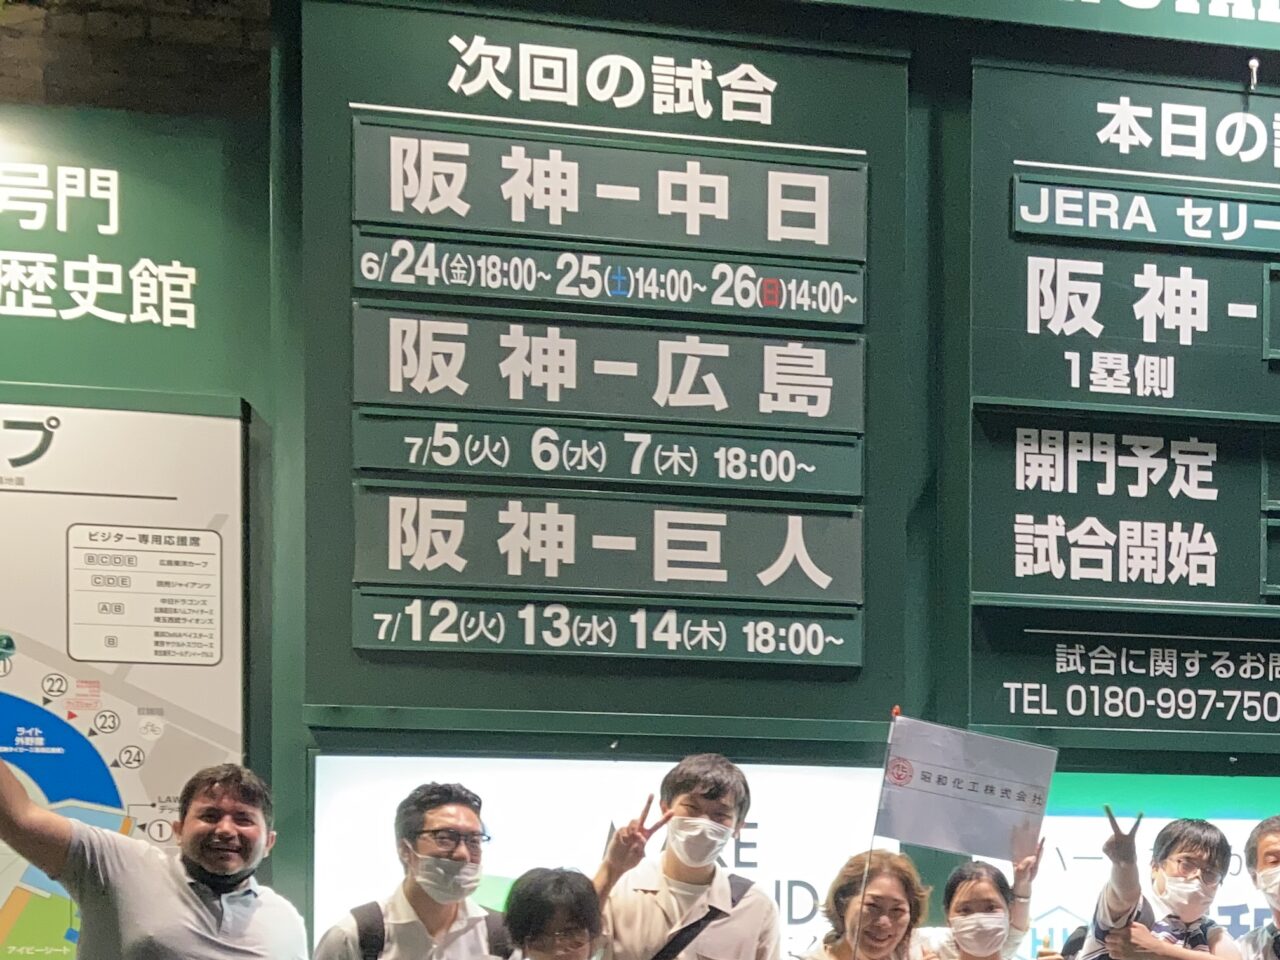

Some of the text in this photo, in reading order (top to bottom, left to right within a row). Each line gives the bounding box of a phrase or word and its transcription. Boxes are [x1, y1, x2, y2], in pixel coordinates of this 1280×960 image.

[447, 34, 778, 125] 次回の試合
[1019, 186, 1157, 234] JERA
[1064, 351, 1175, 398] 1塁側
[3, 416, 61, 468] プ
[1014, 428, 1219, 501] 開門予定
[1013, 514, 1218, 587] 試合開始
[1003, 682, 1058, 717] TEL
